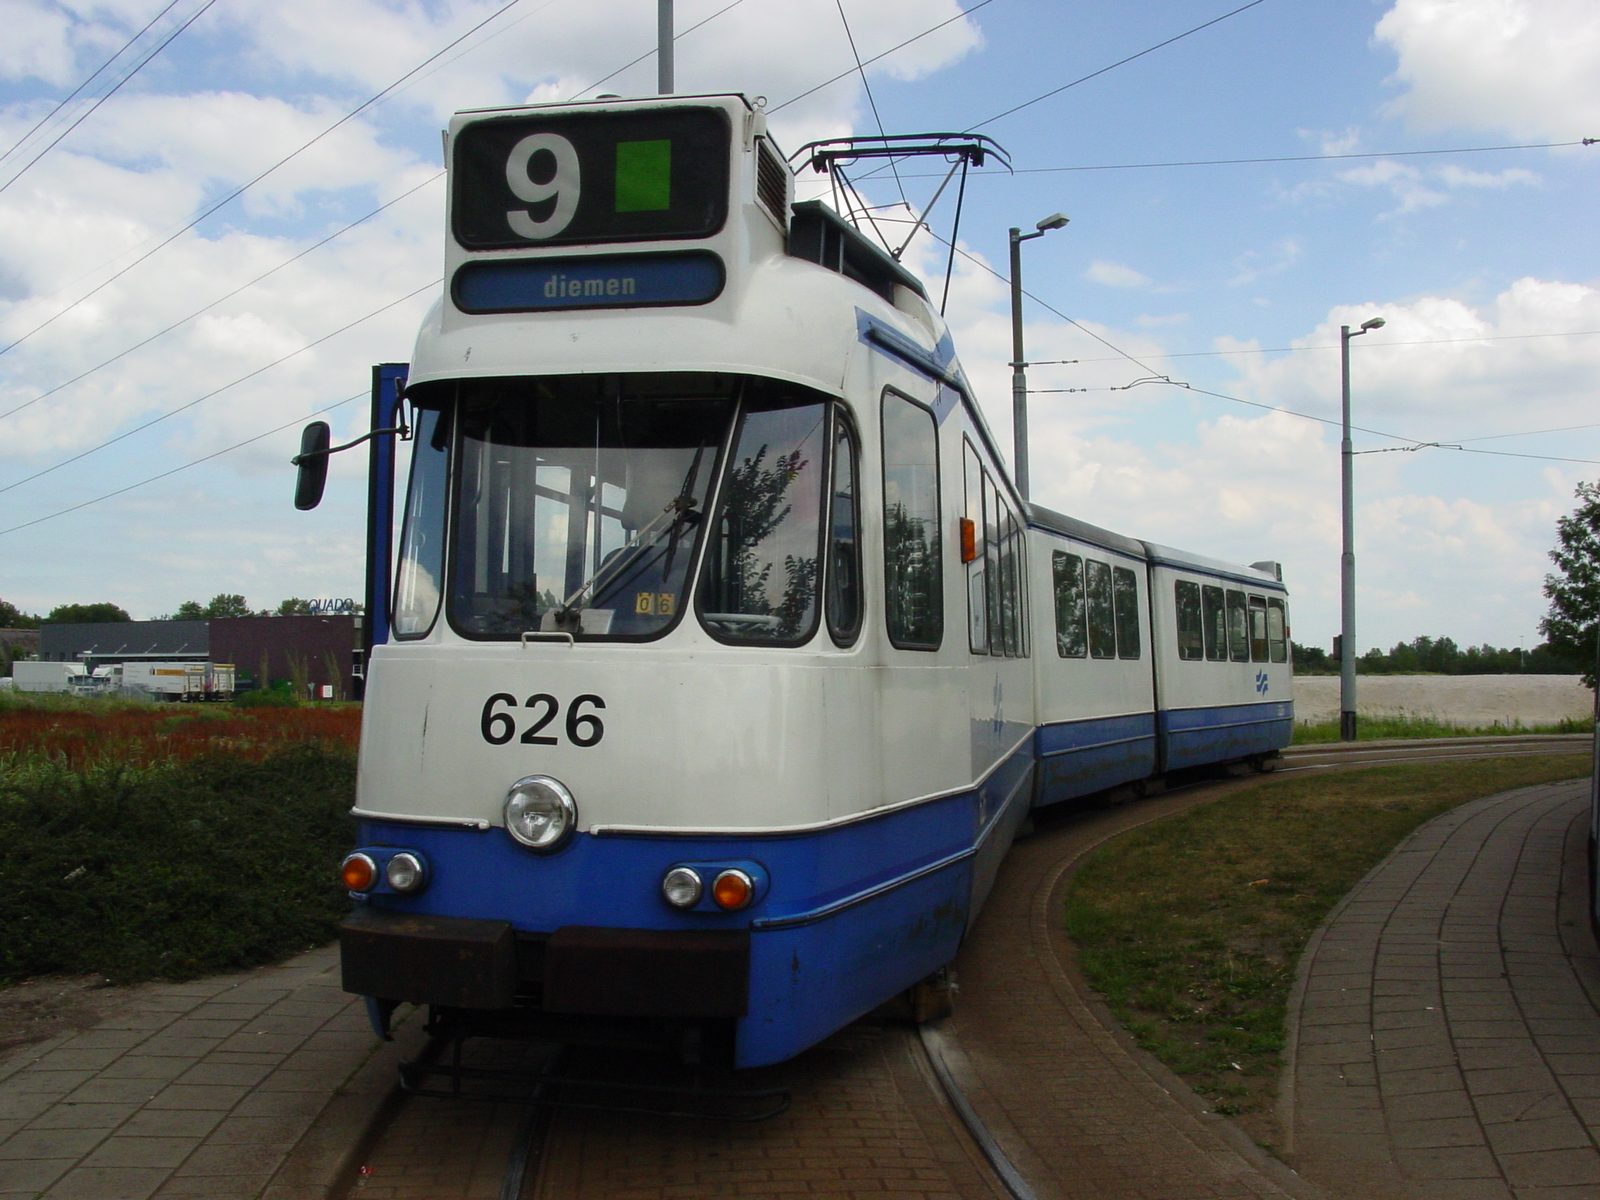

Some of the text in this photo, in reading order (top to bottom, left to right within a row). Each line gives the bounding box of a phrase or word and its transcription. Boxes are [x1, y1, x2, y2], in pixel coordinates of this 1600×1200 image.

[506, 133, 581, 239] 9
[543, 274, 636, 298] diemen
[480, 692, 607, 748] 626
